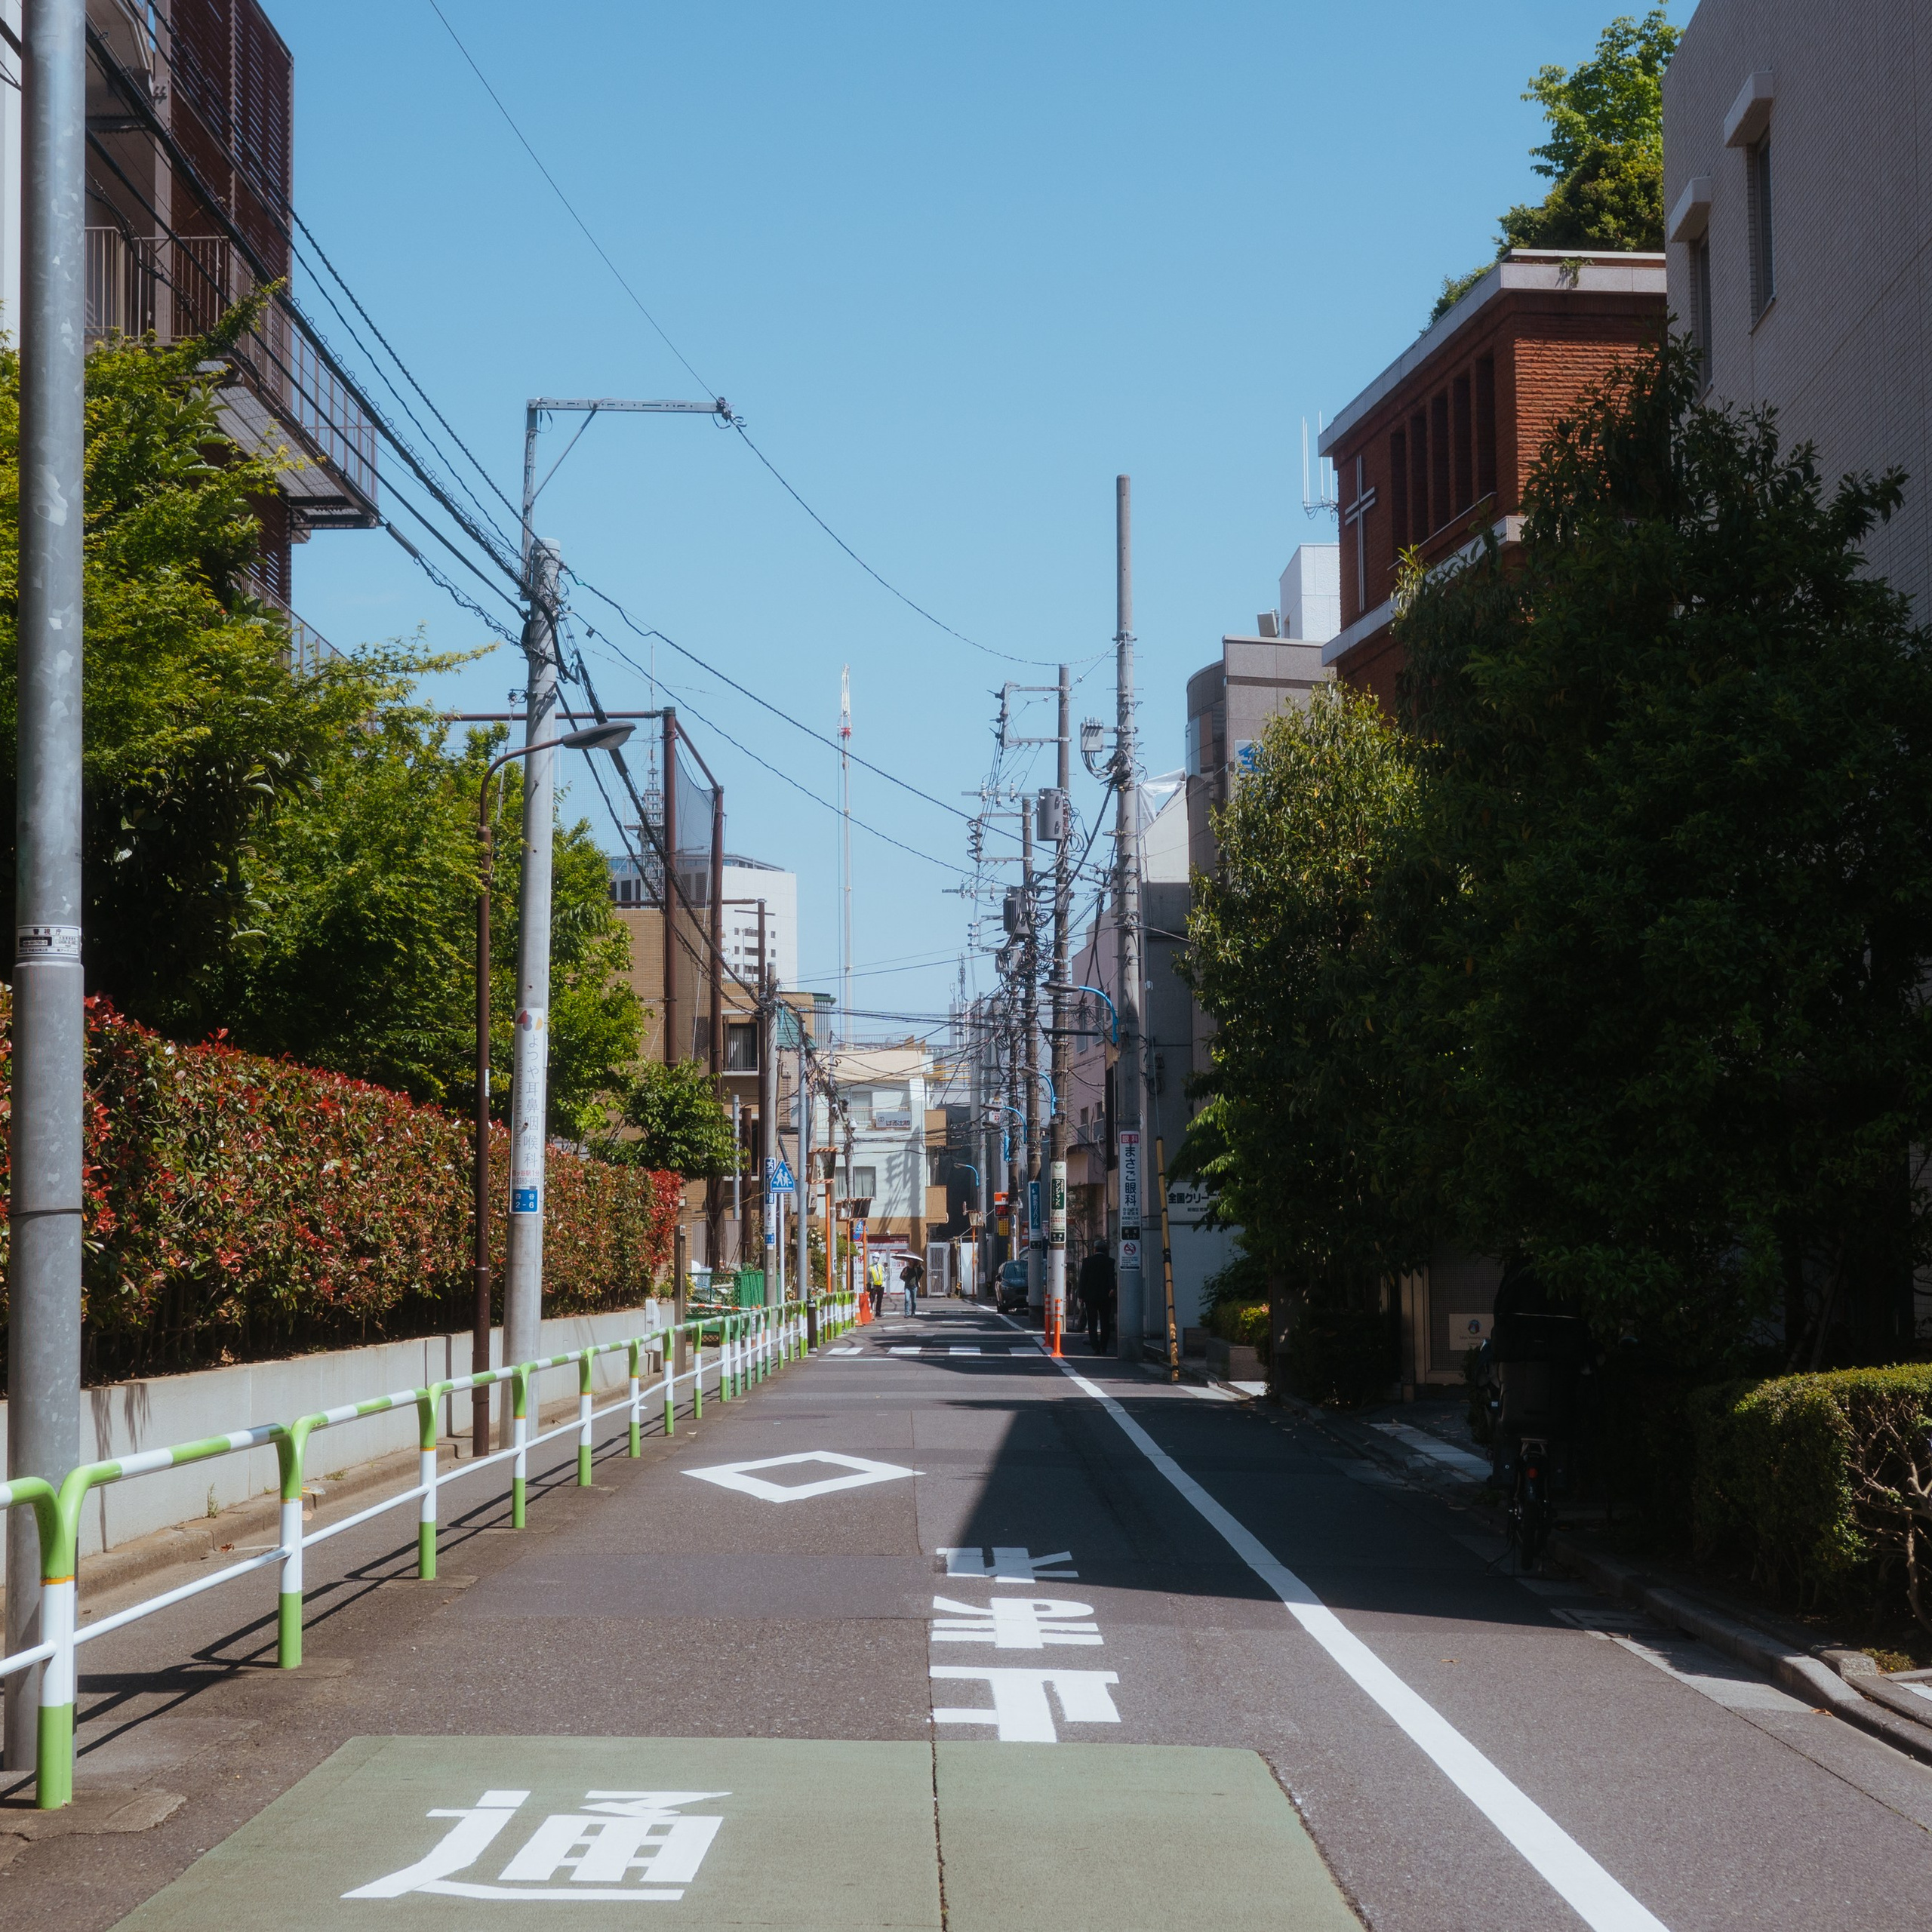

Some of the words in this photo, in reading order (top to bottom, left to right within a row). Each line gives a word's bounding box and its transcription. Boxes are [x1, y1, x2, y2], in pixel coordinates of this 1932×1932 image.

[523, 1034, 540, 1168] よつや耳鼻咽喉科
[1124, 1146, 1137, 1207] まさご眼科
[340, 1790, 732, 1900] 通
